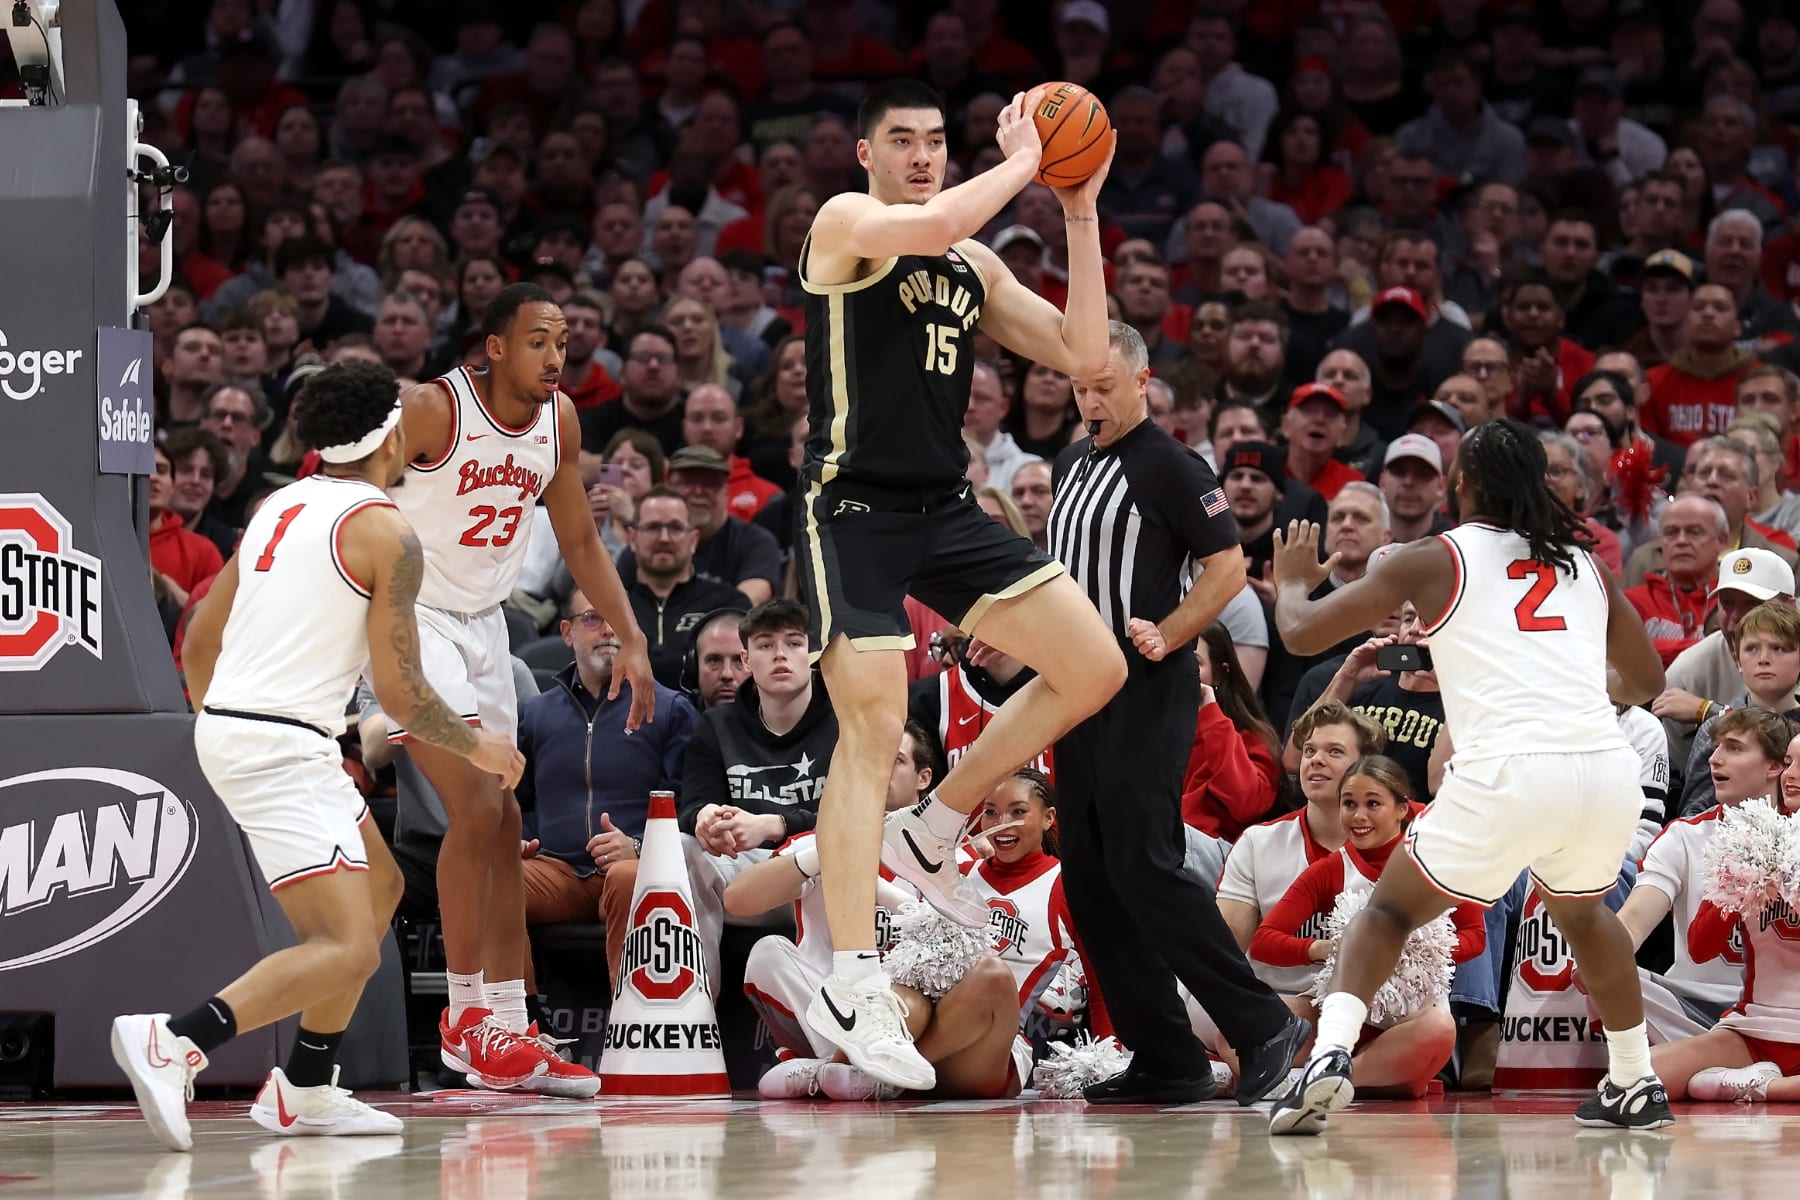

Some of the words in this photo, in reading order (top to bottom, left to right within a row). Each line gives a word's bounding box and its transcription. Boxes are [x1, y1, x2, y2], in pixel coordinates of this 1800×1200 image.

[0, 329, 83, 400] oger
[925, 322, 960, 375] 15
[456, 453, 543, 501] Buckeyes
[254, 503, 307, 572] 1
[459, 504, 523, 547] 23
[2, 543, 98, 651] STATE
[1506, 558, 1568, 631] 2
[1352, 705, 1444, 748] RDU
[604, 1023, 721, 1050] BUCKEYES
[1500, 1015, 1607, 1043] BUCKEY
